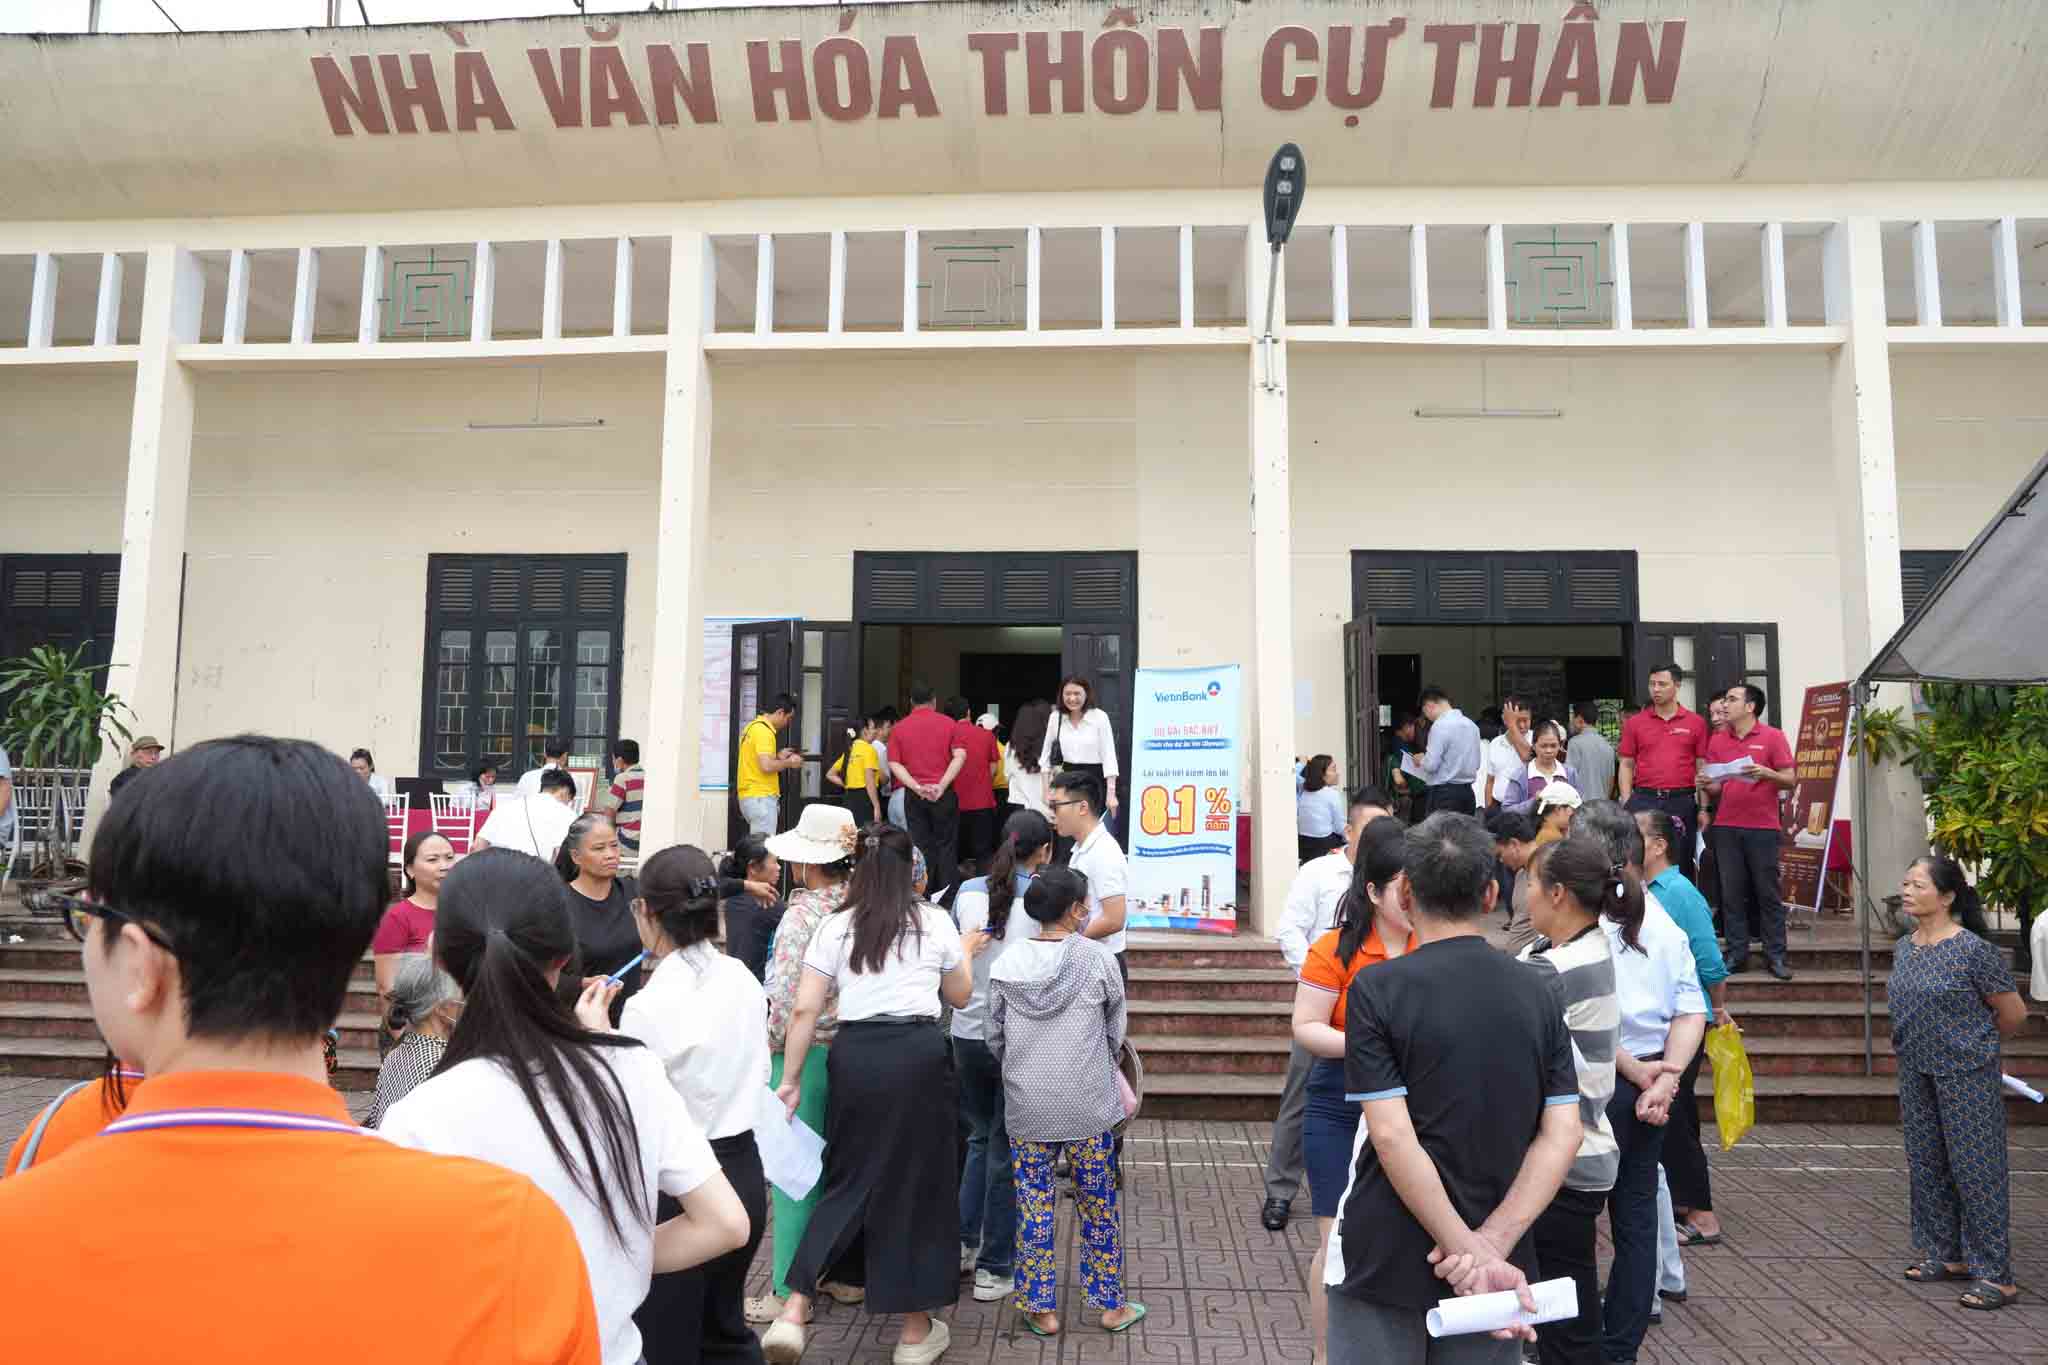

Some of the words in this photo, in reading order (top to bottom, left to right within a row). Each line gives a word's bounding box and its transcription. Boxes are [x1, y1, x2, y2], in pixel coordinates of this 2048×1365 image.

[310, 22, 517, 136] NHÀ
[527, 20, 721, 129] VĂN
[746, 8, 941, 123] HÓA
[967, 6, 1224, 116] THÔN
[1260, 16, 1407, 128] CỰ
[1423, 2, 1687, 109] THÂN
[1154, 688, 1207, 702] VietinBank
[1140, 785, 1196, 836] 8.1
[1204, 787, 1232, 814] %
